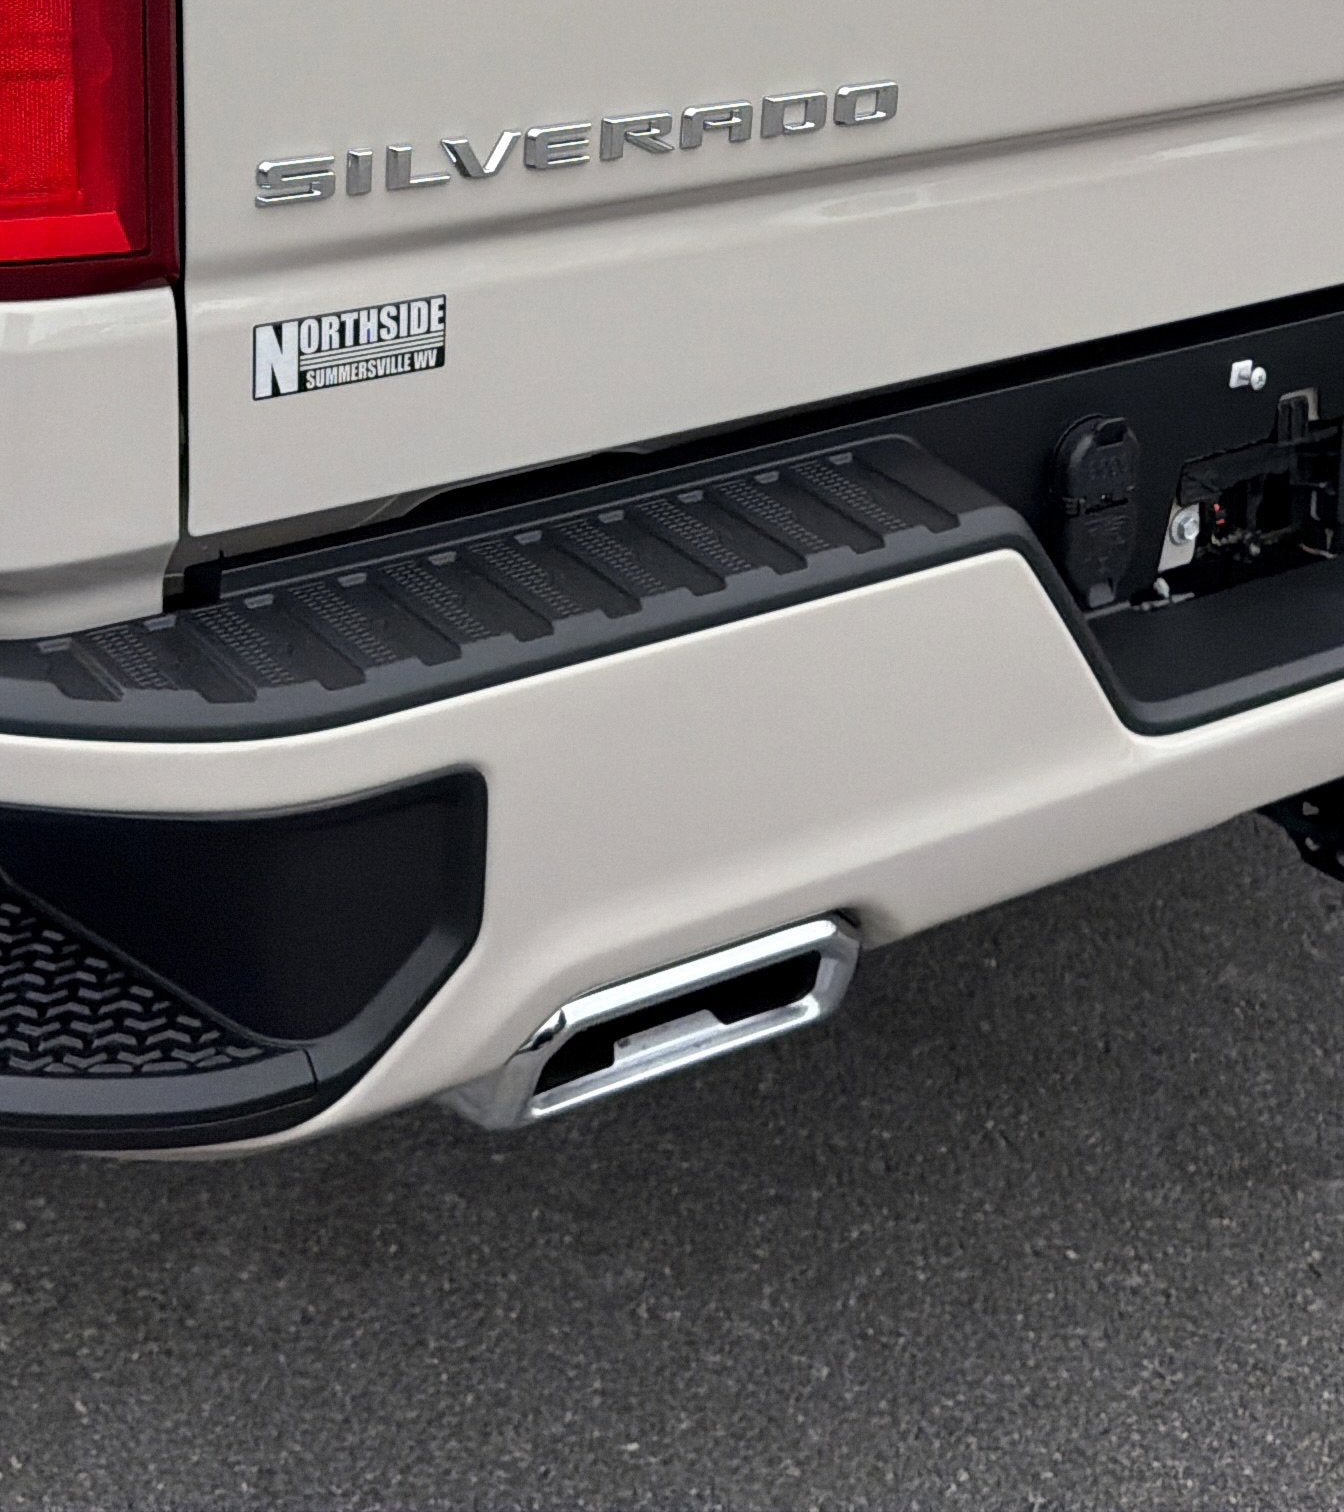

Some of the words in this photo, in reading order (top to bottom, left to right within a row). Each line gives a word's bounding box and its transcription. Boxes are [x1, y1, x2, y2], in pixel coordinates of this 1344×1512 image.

[254, 79, 899, 209] SILVERADO
[255, 297, 445, 398] NORTHSIDE
[305, 353, 412, 389] SUMMERSVILLE
[413, 348, 438, 370] WV
